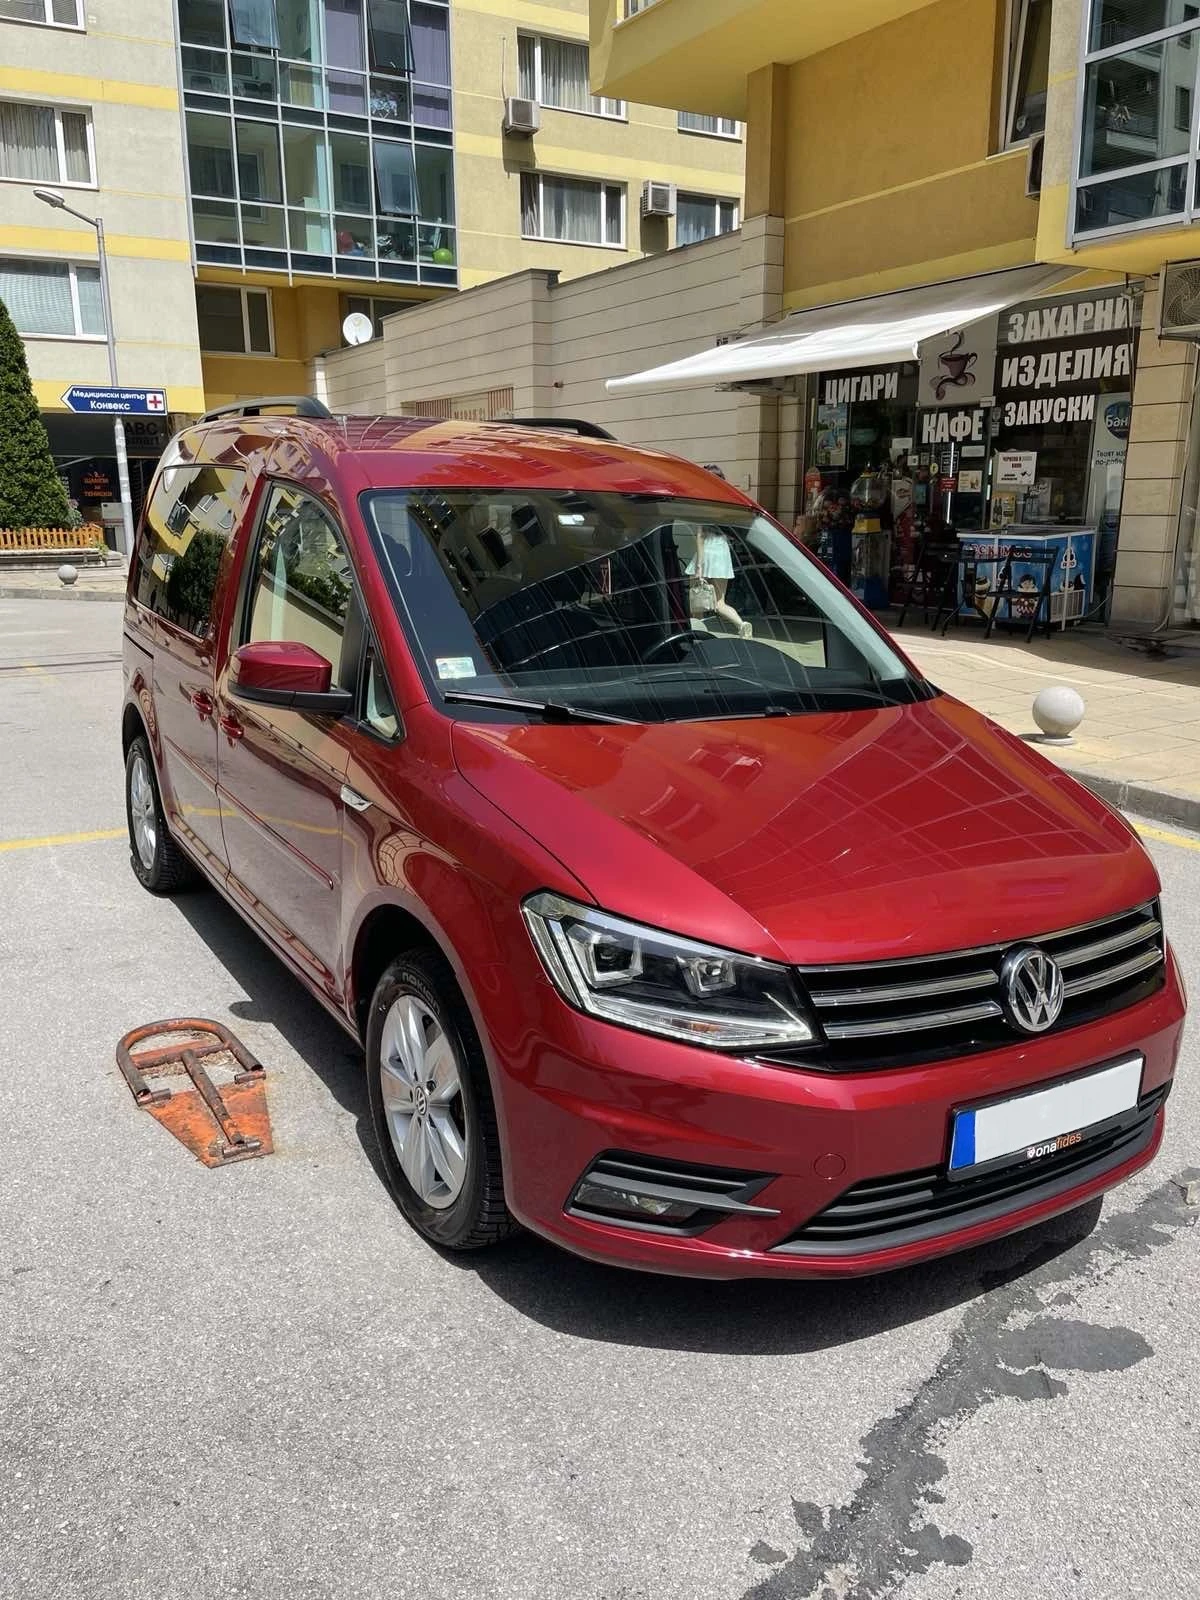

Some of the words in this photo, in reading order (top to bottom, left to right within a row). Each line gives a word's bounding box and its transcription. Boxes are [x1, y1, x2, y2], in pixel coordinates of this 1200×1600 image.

[1007, 296, 1134, 344] ЗАХАРНИ
[1001, 343, 1134, 389] ИЗДЕЛИЯ
[72, 390, 120, 399] Медицински
[120, 392, 146, 400] център
[90, 400, 131, 410] Конвекс
[825, 372, 899, 408] ЦИГАРИ
[921, 409, 984, 444] КАФЕ
[1004, 394, 1096, 427] ЗАКУСКИ
